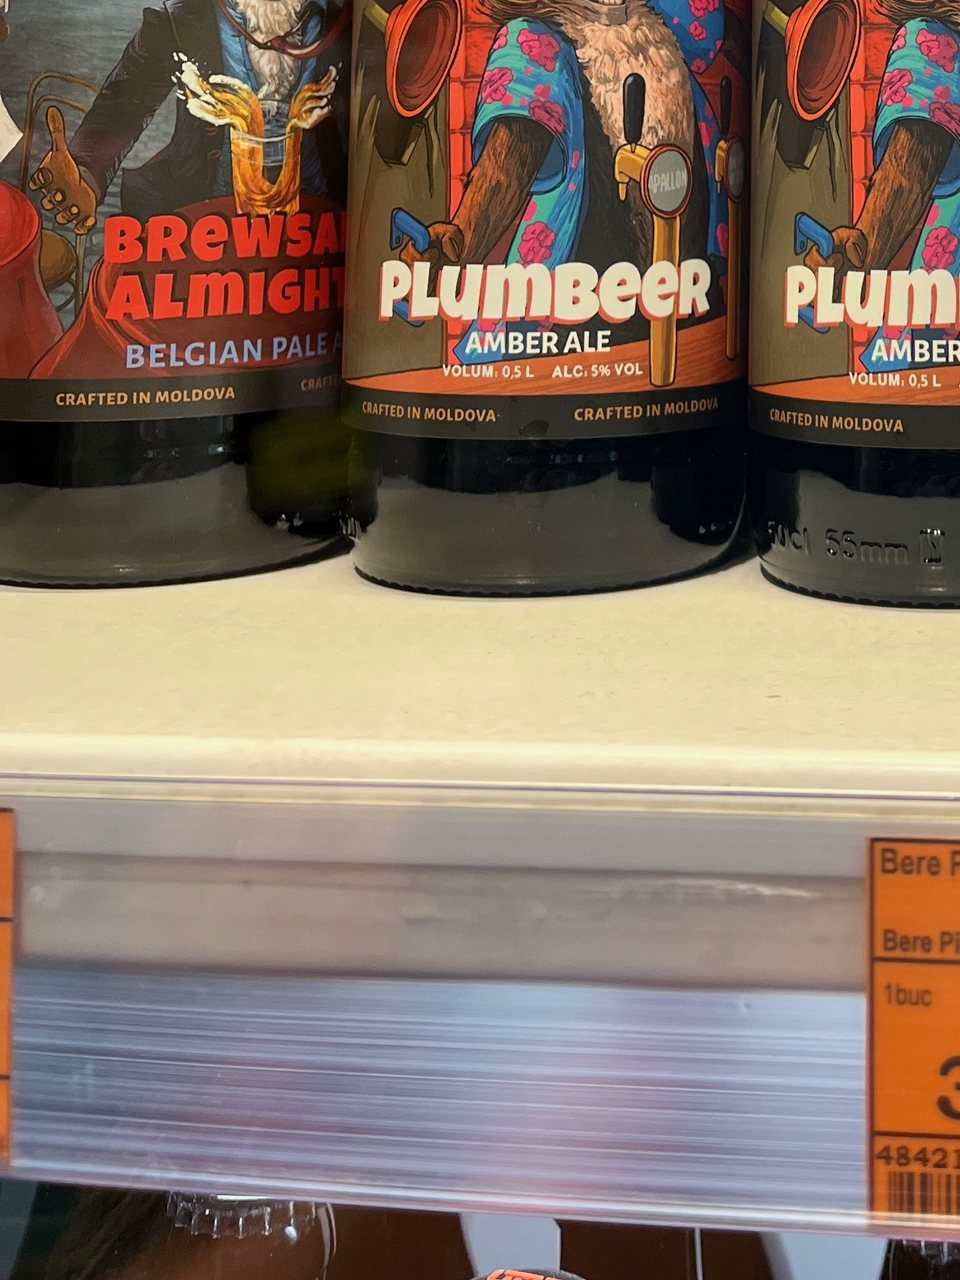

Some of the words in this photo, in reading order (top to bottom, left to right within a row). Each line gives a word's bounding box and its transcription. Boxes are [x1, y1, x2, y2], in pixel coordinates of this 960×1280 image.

[126, 338, 263, 369] BELGIAN
[272, 332, 328, 361] PALE
[465, 331, 558, 355] AMBER
[563, 330, 611, 353] ALE
[526, 365, 535, 378] L
[591, 363, 611, 377] 5%
[614, 362, 643, 376] VOL
[932, 374, 942, 388] L
[56, 392, 129, 406] CRAFTED
[132, 391, 151, 405] IN
[155, 387, 235, 404] MOLDOVA
[362, 401, 404, 418] CRAFTED
[406, 405, 421, 419] IN
[424, 406, 496, 422] MOLDOVA
[574, 405, 643, 421] CRAFTED
[646, 403, 661, 418] IN
[664, 398, 719, 415] MOLDOVA
[769, 408, 812, 427] CRAFTED
[814, 413, 829, 428] IN
[832, 416, 904, 434] MOLDOVA
[880, 848, 939, 876] Bere
[882, 929, 932, 953] Bere
[884, 983, 932, 1008] 1buc
